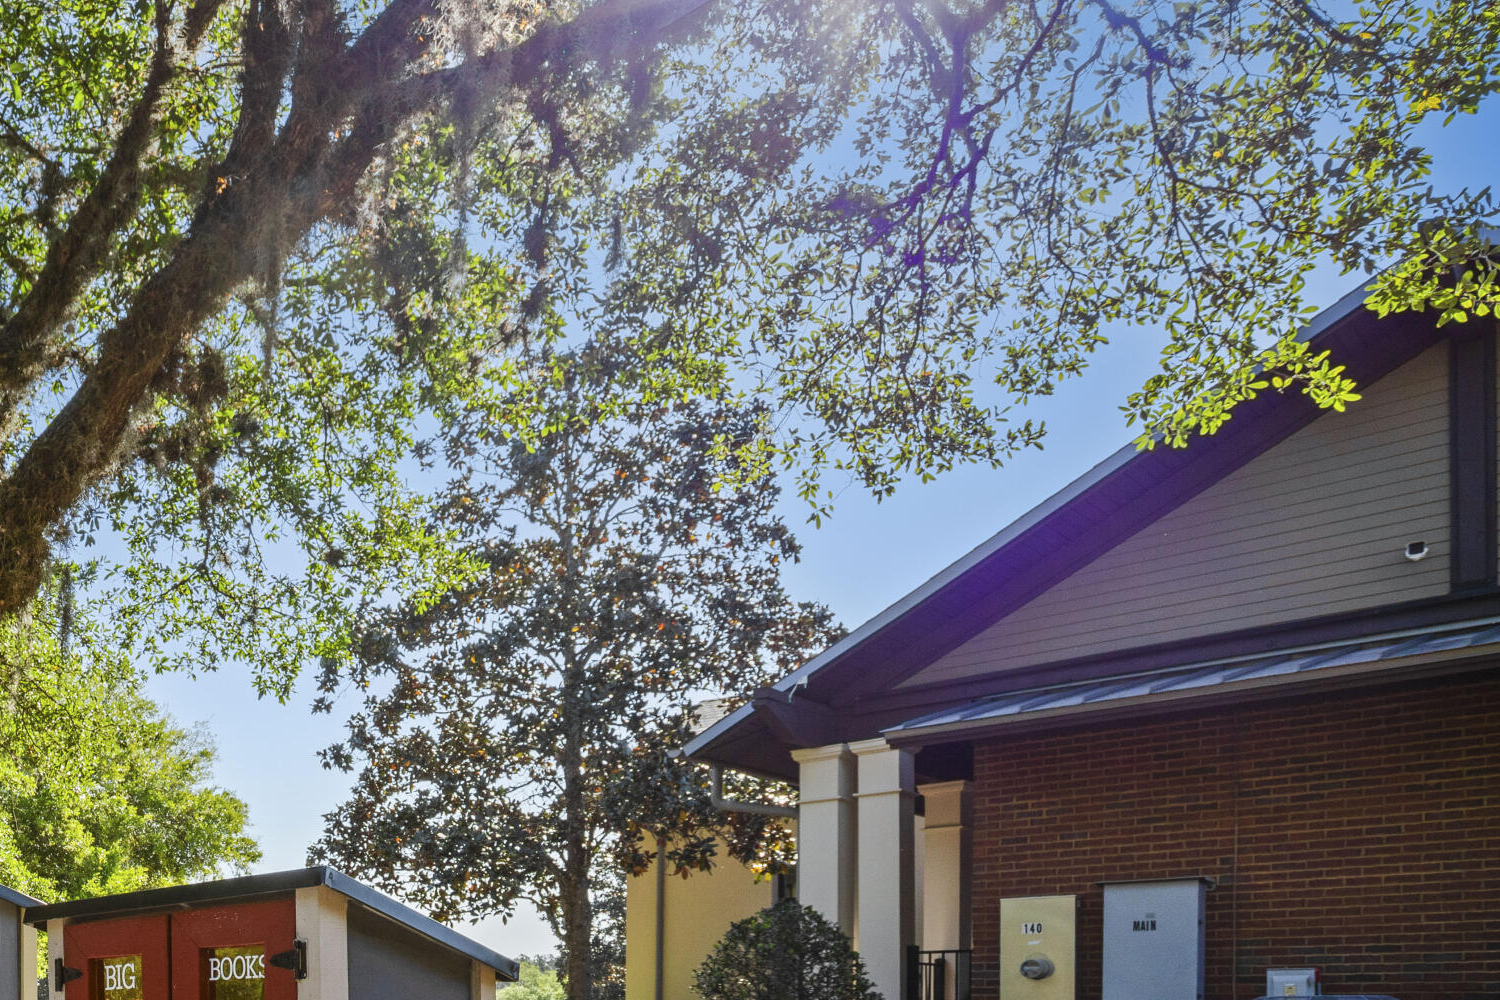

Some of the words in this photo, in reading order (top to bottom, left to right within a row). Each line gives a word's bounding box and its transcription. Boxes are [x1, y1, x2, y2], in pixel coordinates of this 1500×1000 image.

[1024, 923, 1043, 934] 140
[1132, 920, 1157, 932] MAIN
[105, 963, 136, 991] BIG
[209, 954, 265, 981] BOOKS
